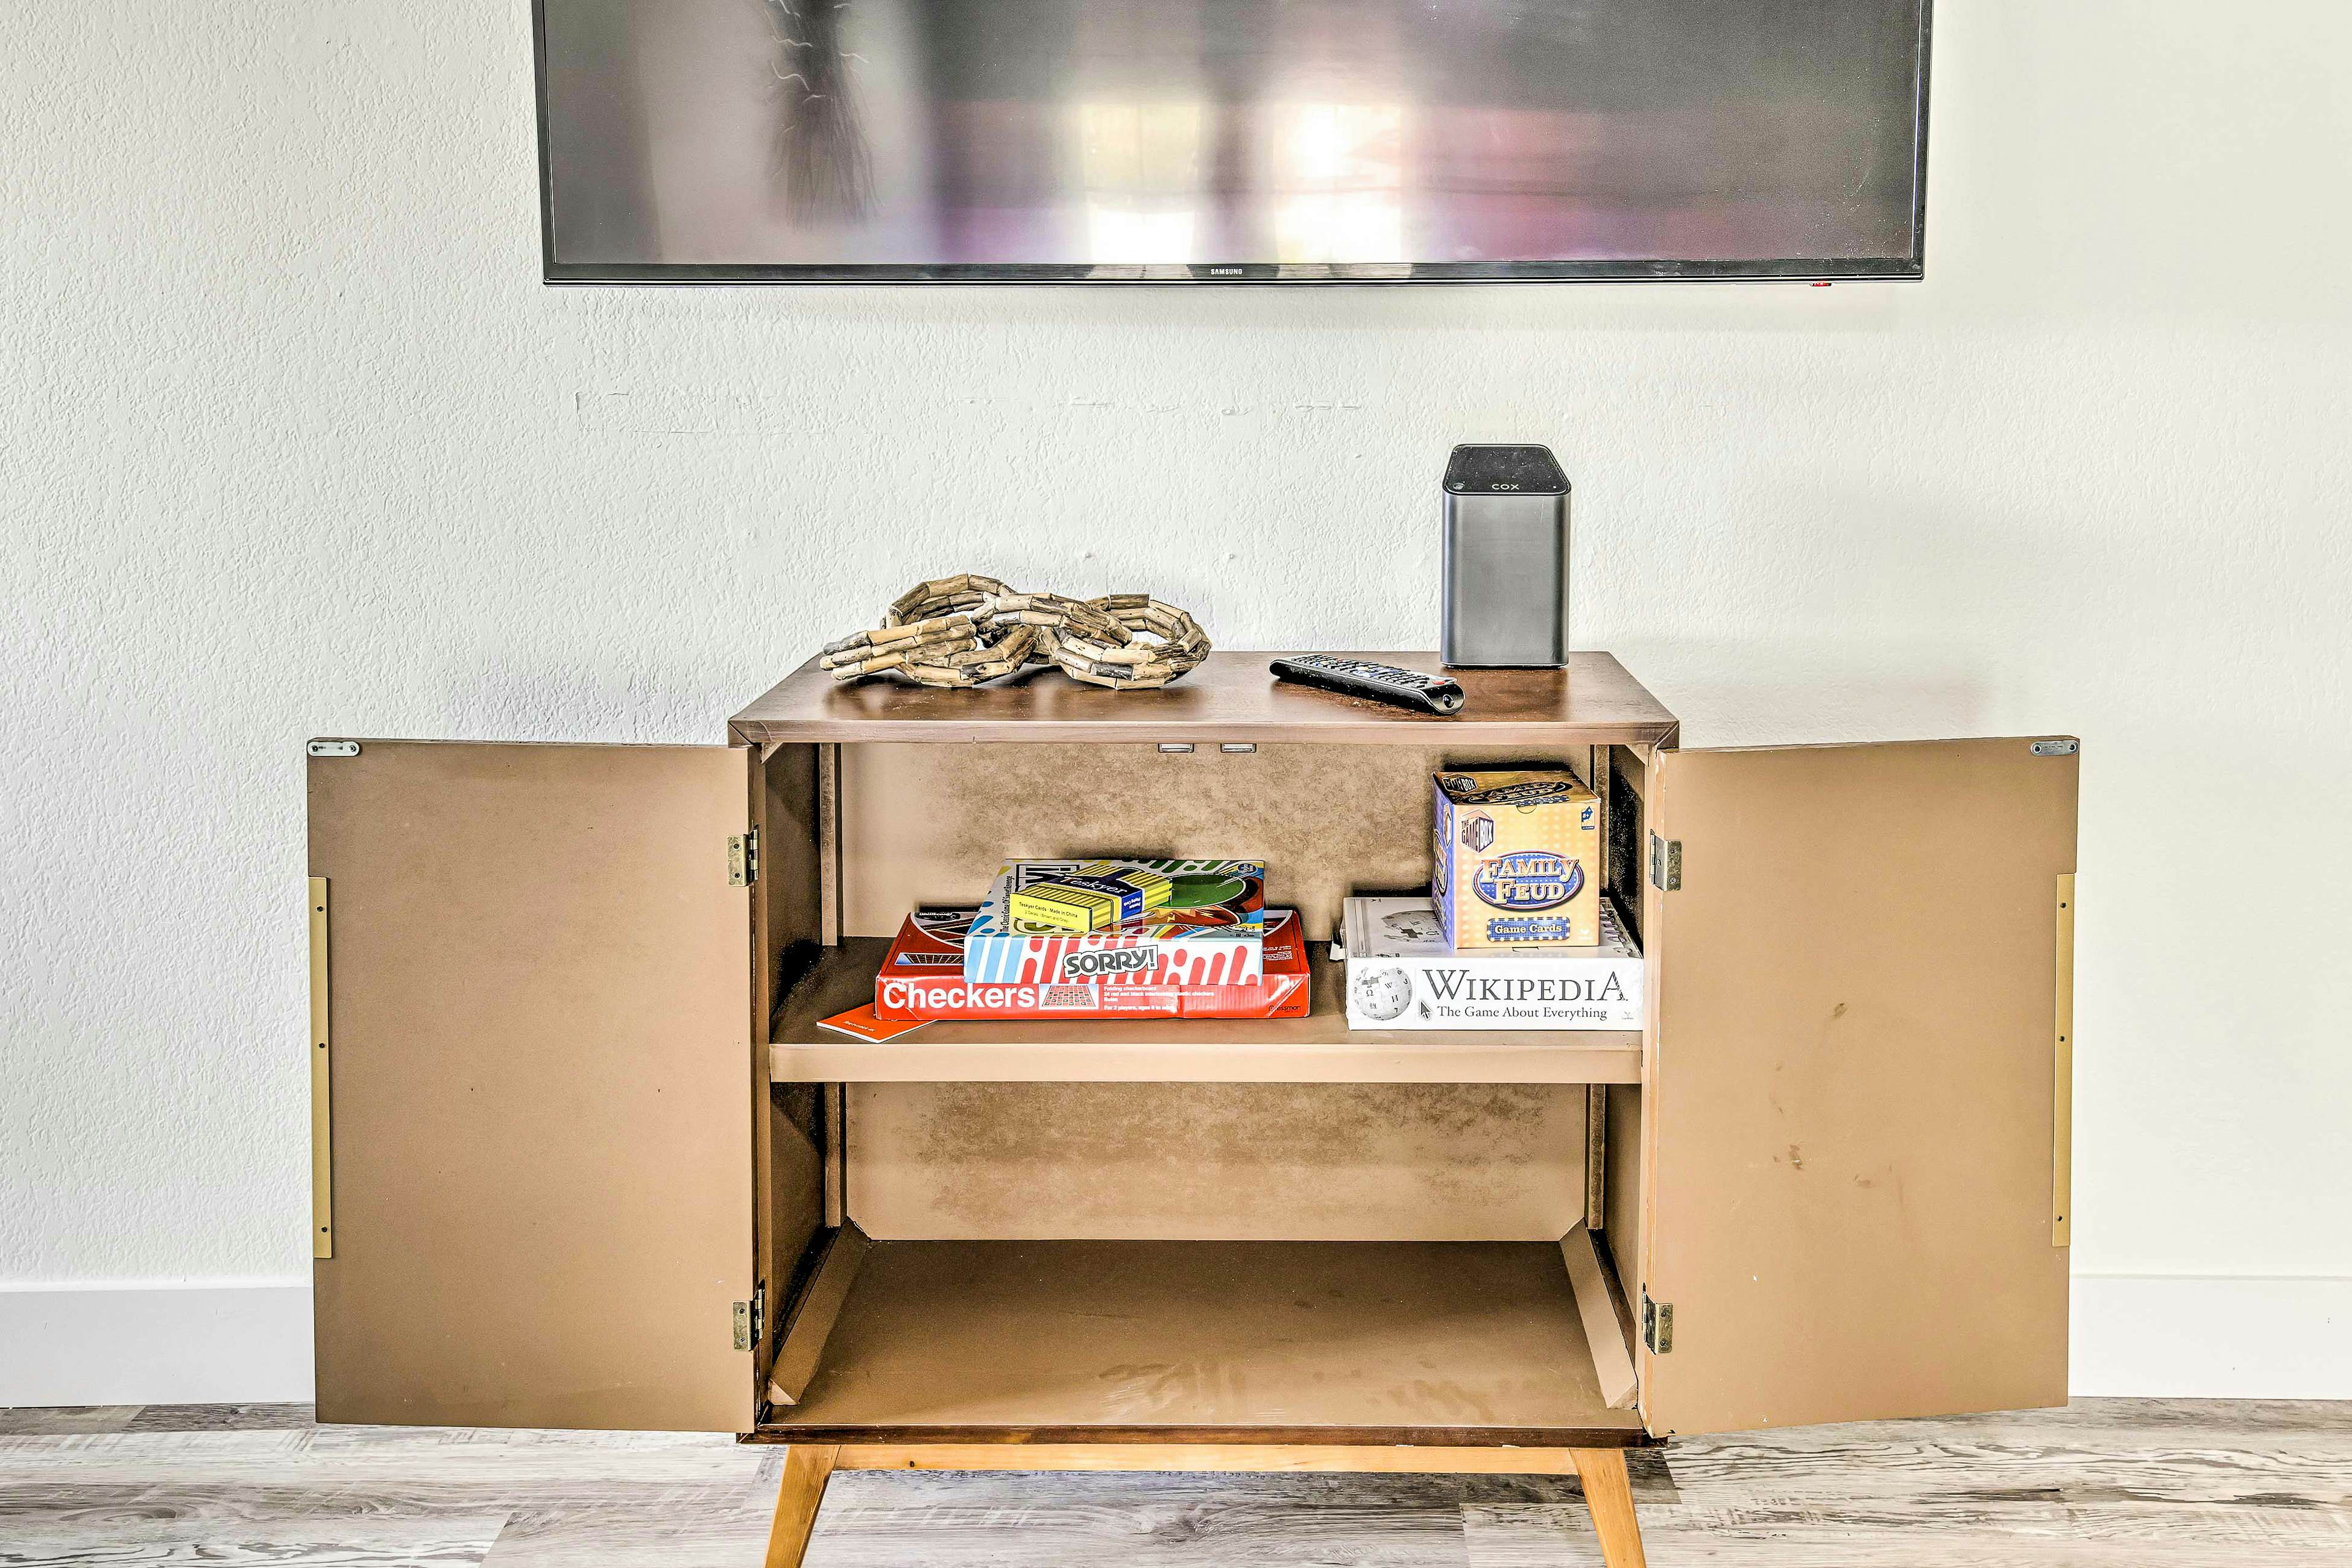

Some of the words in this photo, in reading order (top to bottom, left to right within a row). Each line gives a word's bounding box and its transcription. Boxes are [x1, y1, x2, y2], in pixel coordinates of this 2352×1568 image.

[1461, 820, 1478, 852] GAME
[1479, 817, 1493, 852] BOX
[1480, 858, 1579, 883] FAMILY
[1059, 877, 1127, 892] Teskyer
[1493, 878, 1565, 904] FEUD
[1495, 925, 1526, 934] Game
[1530, 924, 1562, 933] Cards
[1067, 949, 1155, 975] SORRY!
[883, 983, 1035, 1009] Checkers
[1422, 969, 1628, 1001] WIKIPEDIA
[1437, 1006, 1461, 1016] The
[1464, 1006, 1499, 1017] Game
[1502, 1007, 1539, 1017] About
[1543, 1007, 1607, 1021] Everything
